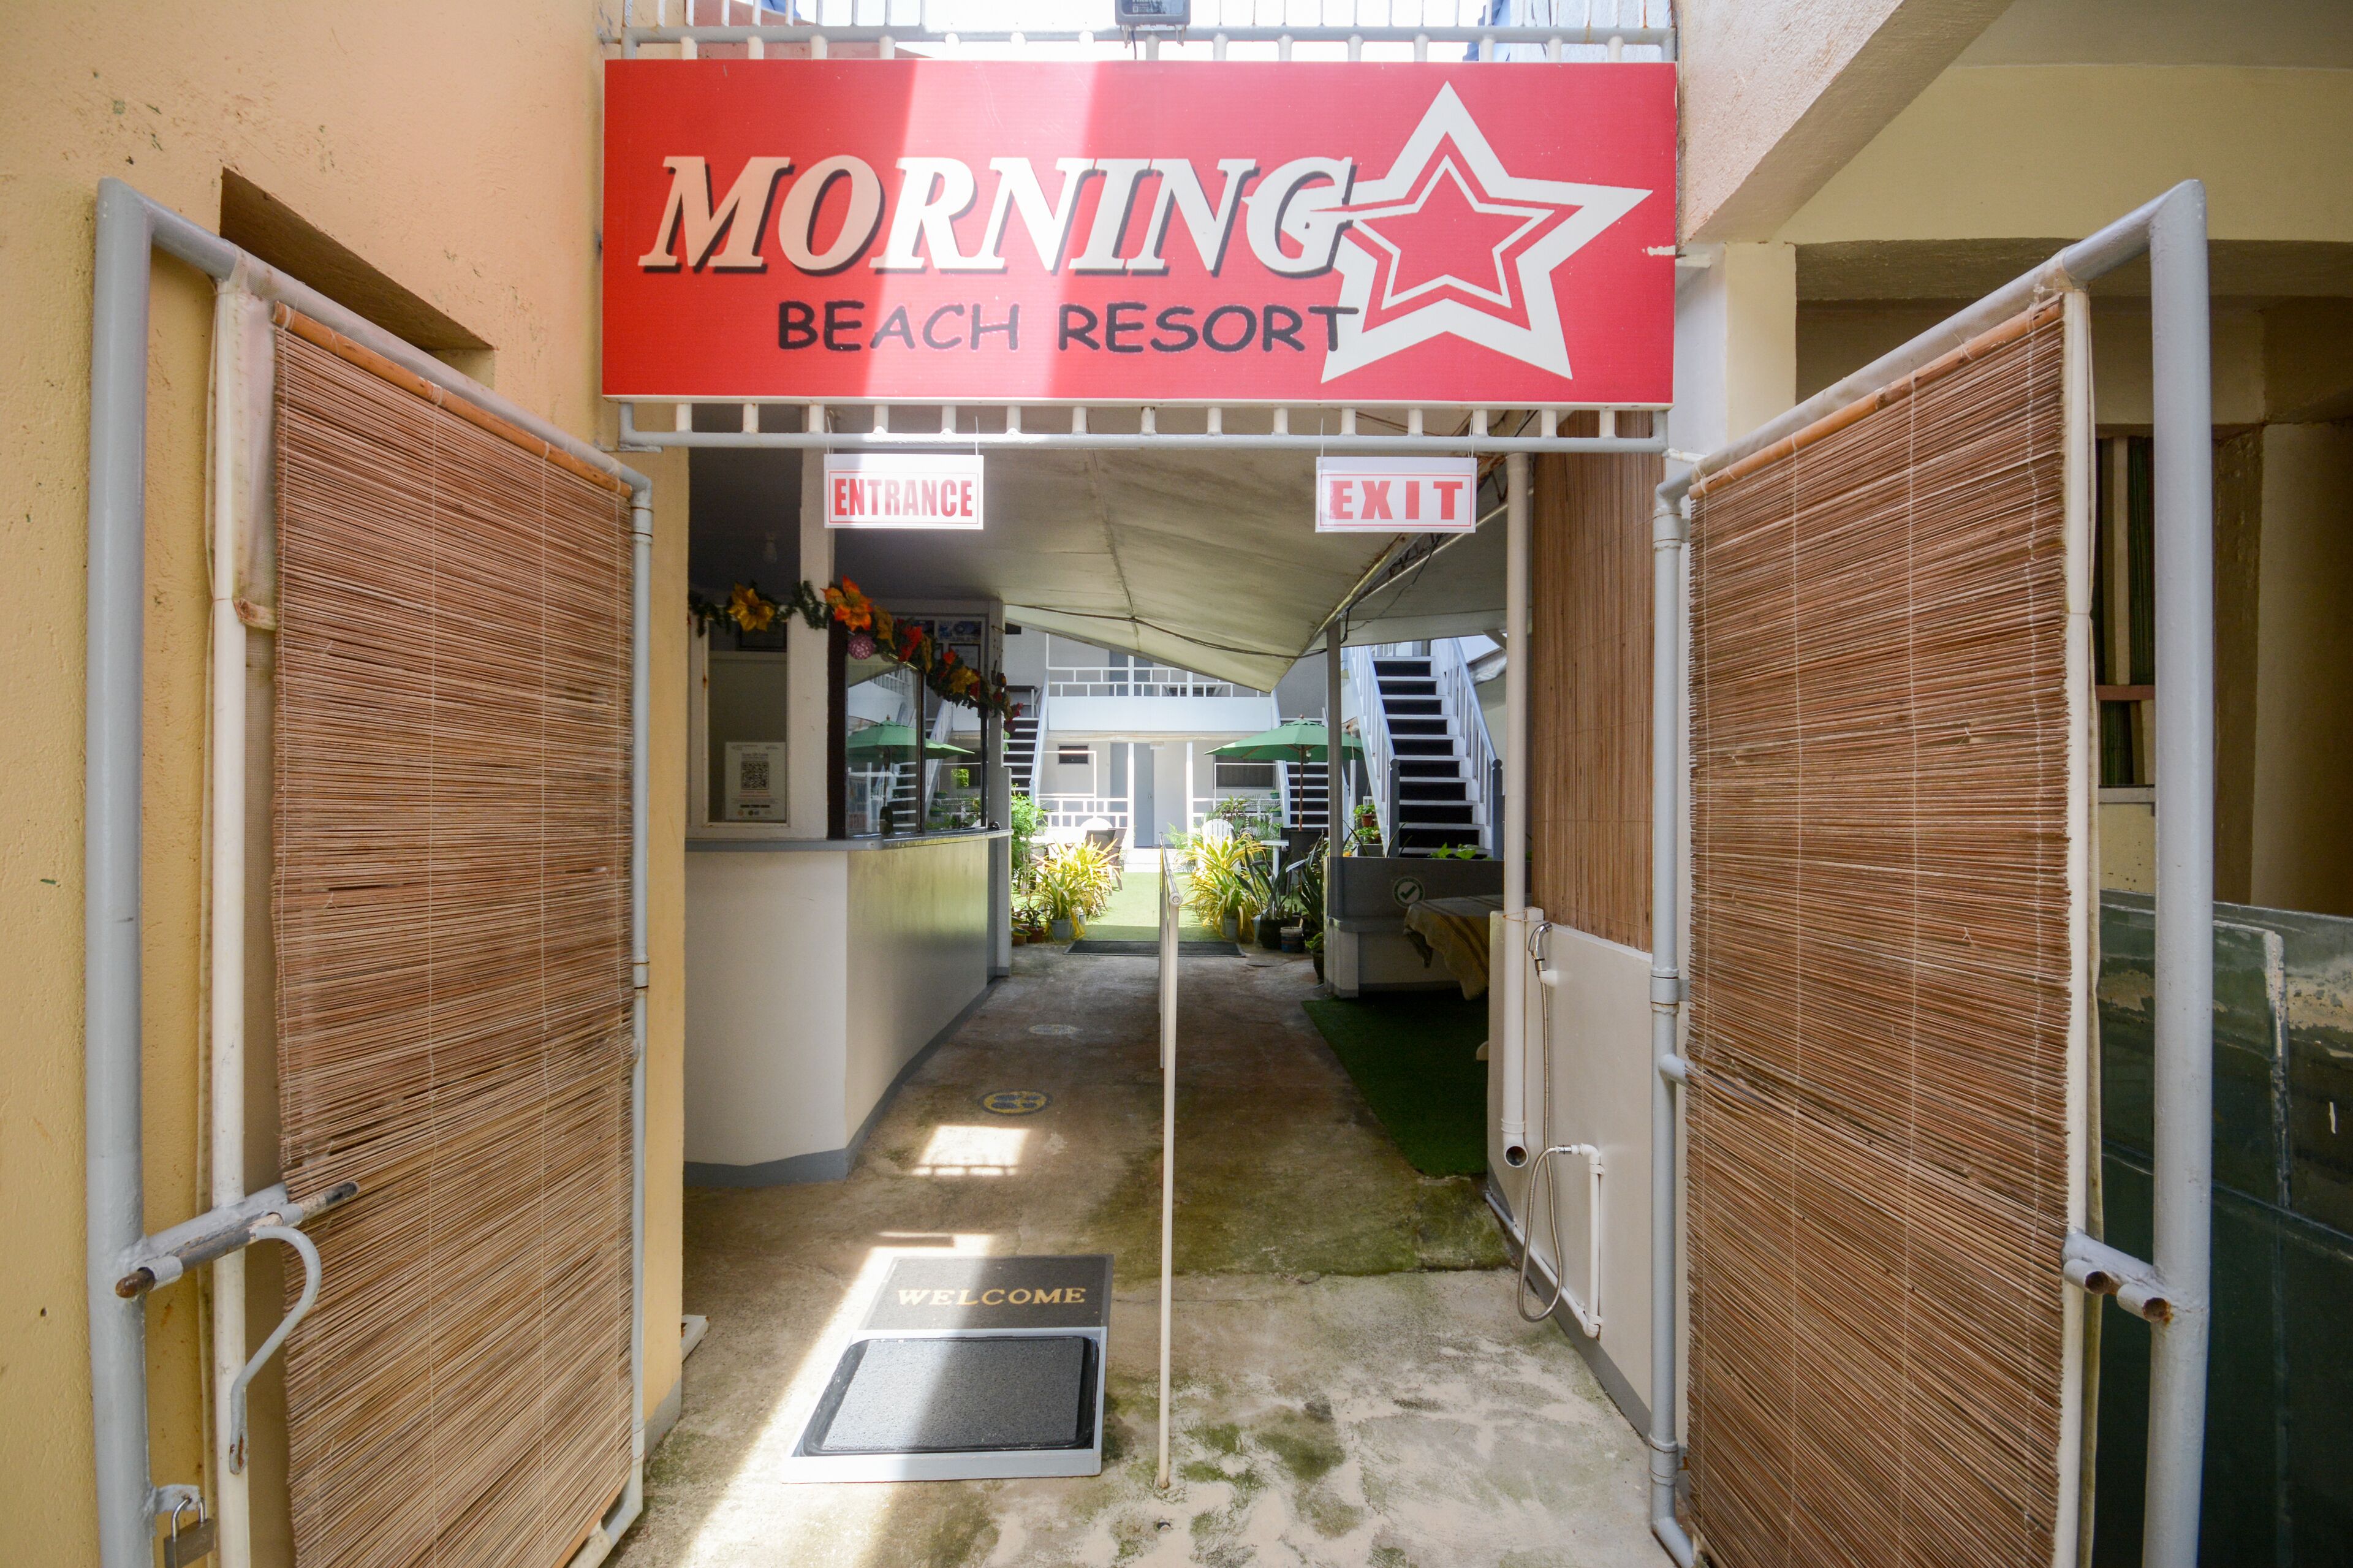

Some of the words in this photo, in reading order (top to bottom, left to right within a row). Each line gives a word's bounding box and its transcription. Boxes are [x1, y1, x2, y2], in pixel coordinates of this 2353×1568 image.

[637, 155, 1355, 276] MORNING
[779, 300, 1019, 352] BEACH
[1058, 301, 1359, 353] RESORT
[834, 479, 972, 517] ENTRANCE
[1329, 480, 1463, 520] EXIT
[897, 1288, 1086, 1306] WELCOME
